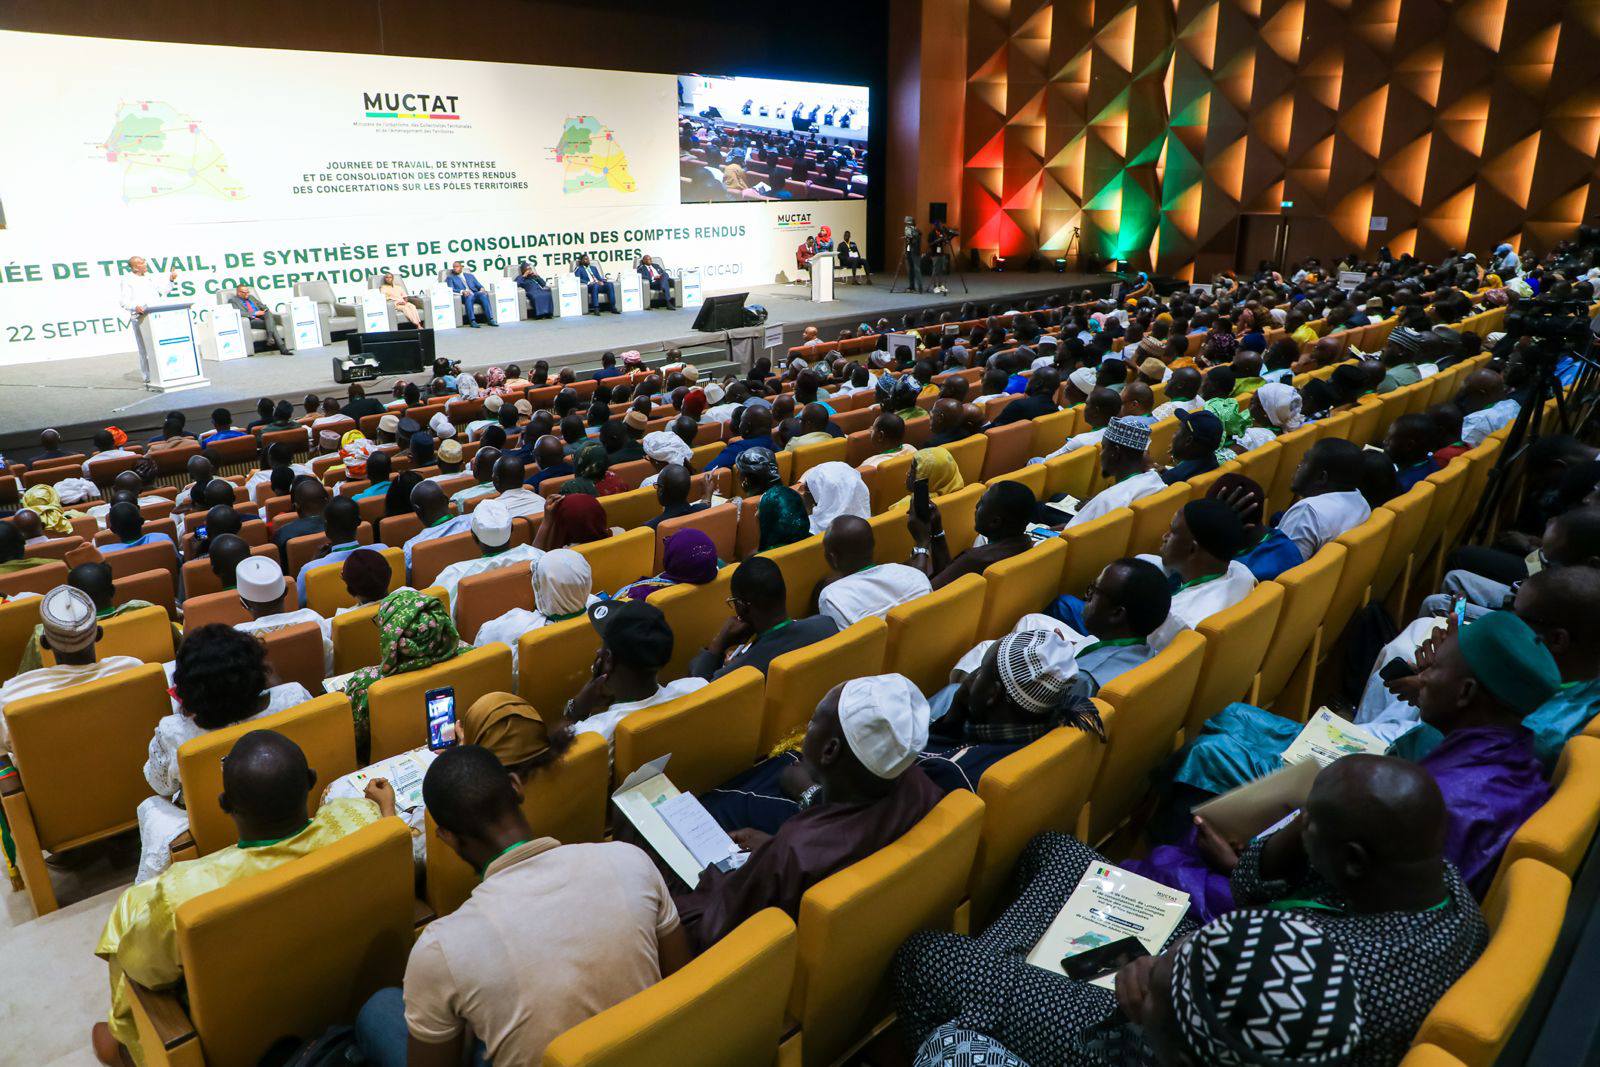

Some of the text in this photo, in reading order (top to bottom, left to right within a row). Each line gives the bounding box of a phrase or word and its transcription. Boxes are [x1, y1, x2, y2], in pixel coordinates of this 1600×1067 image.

[363, 92, 459, 113] MUCTAT
[376, 161, 389, 169] DE
[392, 160, 434, 169] TRAVAIL,
[436, 161, 448, 169] DE
[303, 171, 517, 182] ET DE CONSOLIDATION DES COMPTES RENDUS
[293, 185, 314, 195] DES
[316, 183, 400, 194] CONCERTATIONS
[402, 182, 421, 191] SUR
[424, 182, 441, 191] LES
[474, 181, 529, 190] TERRITOIRES
[777, 213, 811, 222] MUCTAT
[52, 262, 90, 280] DE
[224, 252, 256, 269] DE
[263, 242, 379, 266] SYNTHÈSE
[385, 242, 410, 258] ET
[416, 240, 442, 255] DE
[447, 231, 585, 253] CONSOLIDATION
[590, 230, 619, 244] DES
[623, 227, 690, 242] COMPTES
[695, 225, 746, 239] RENDUS
[398, 262, 438, 279] SUR
[543, 248, 643, 267] TERRTOIRES
[6, 316, 133, 342] 22 SEPTEM
